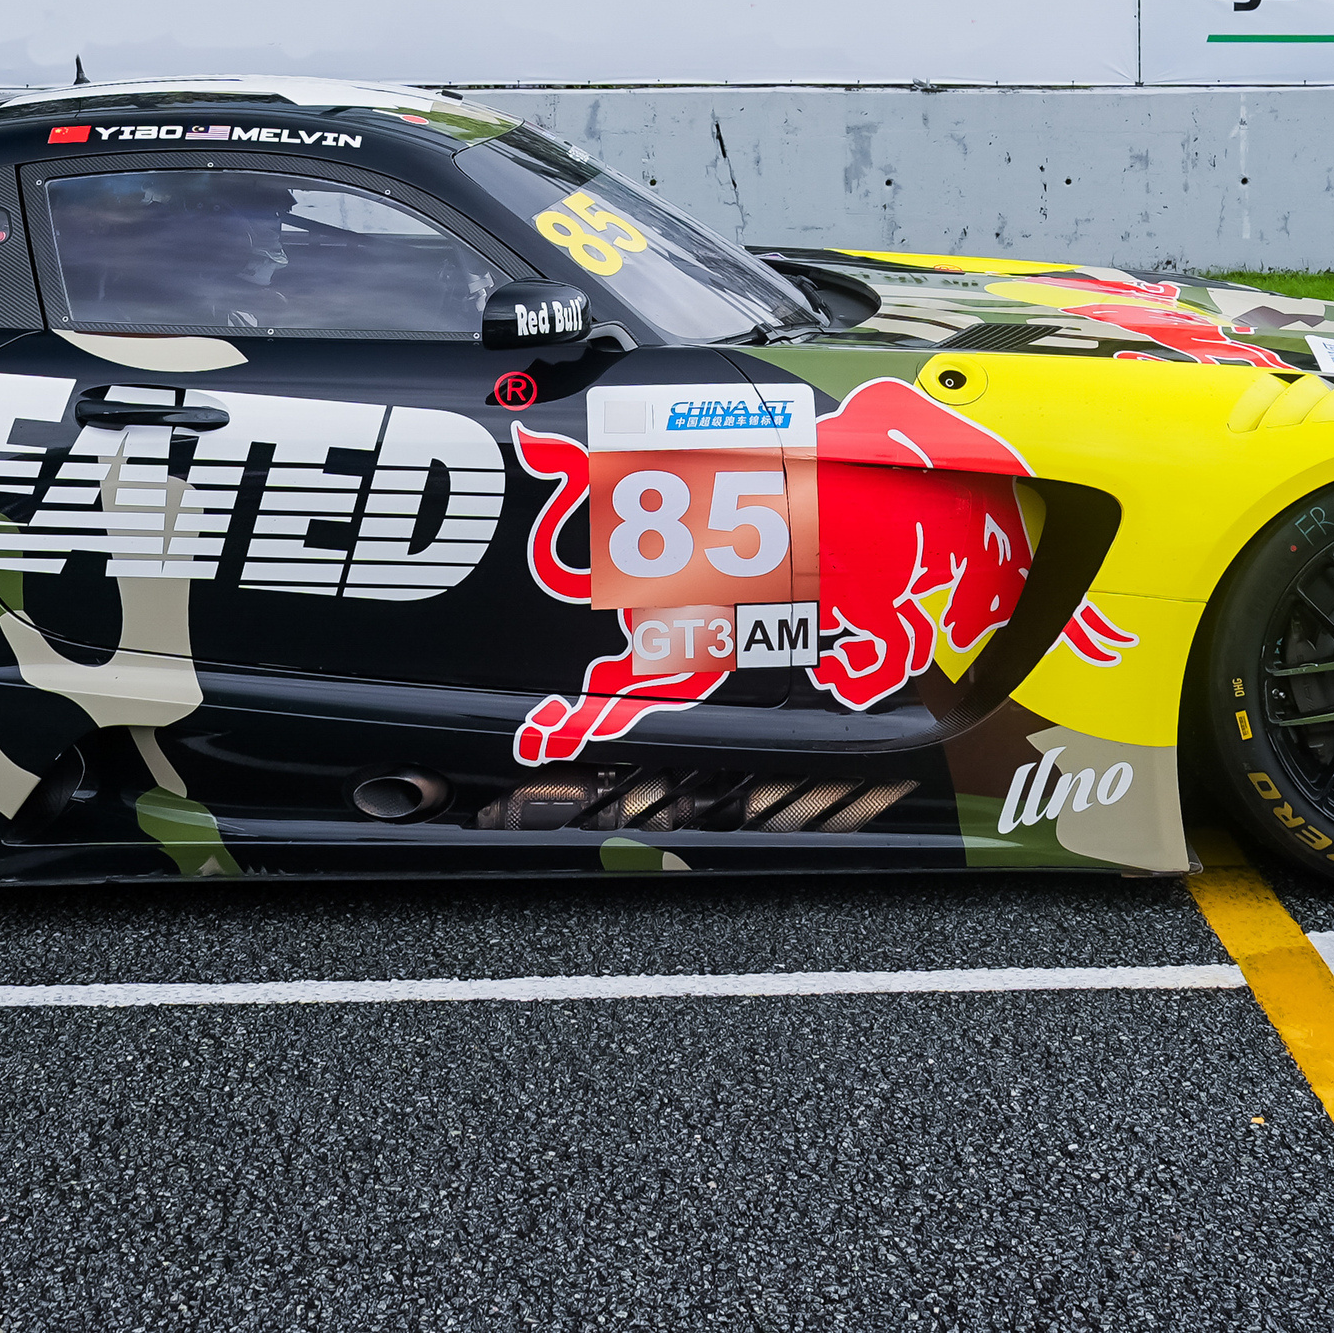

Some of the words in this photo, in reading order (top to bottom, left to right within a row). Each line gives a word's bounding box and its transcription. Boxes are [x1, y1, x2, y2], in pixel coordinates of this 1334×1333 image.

[95, 125, 184, 141] YIBO
[232, 125, 362, 148] MELVIN
[535, 191, 648, 277] 85
[514, 301, 551, 337] Red
[552, 298, 583, 334] Bull
[670, 400, 750, 415] CHINA
[757, 400, 795, 415] GT
[608, 469, 790, 578] 85
[631, 618, 735, 660] GT3
[743, 617, 810, 652] AM
[1231, 677, 1246, 698] DHG
